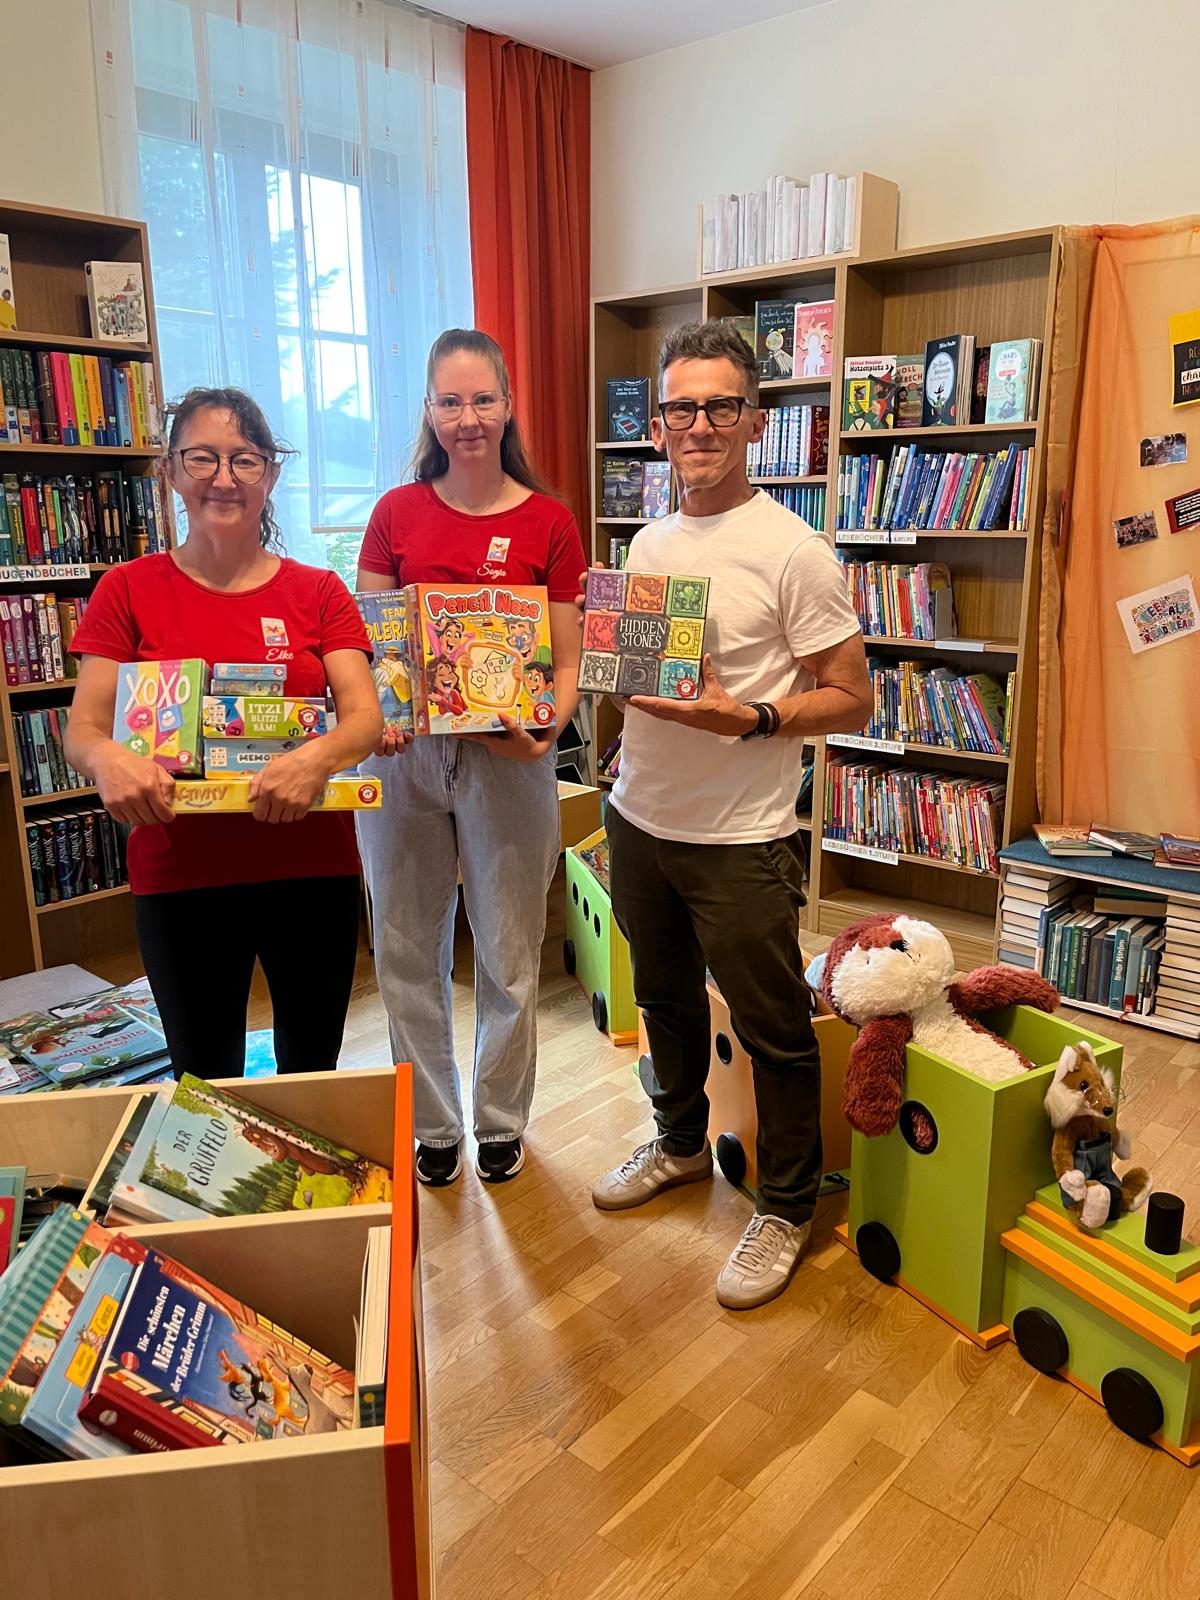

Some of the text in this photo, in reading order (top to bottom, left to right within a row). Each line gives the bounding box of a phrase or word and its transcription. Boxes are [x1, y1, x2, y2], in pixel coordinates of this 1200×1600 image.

[427, 590, 541, 620] Pencil Nose
[619, 618, 667, 636] HIDDEN
[620, 632, 663, 649] STONES
[265, 648, 295, 661] Elke
[124, 671, 191, 714] XOXO
[247, 703, 283, 714] ITZI
[250, 714, 279, 723] BLITZI
[252, 722, 277, 733] BÄM!
[828, 735, 873, 748] LESEBÜCHER
[823, 839, 868, 856] LESEBÜCHER
[173, 1129, 193, 1152] DER
[187, 1118, 228, 1186] GRÜFFELO
[137, 1285, 170, 1353] Die schönsten
[152, 1304, 186, 1372] Märchen
[170, 1377, 182, 1393] der
[177, 1339, 196, 1379] Brüder
[187, 1301, 207, 1340] Grimm
